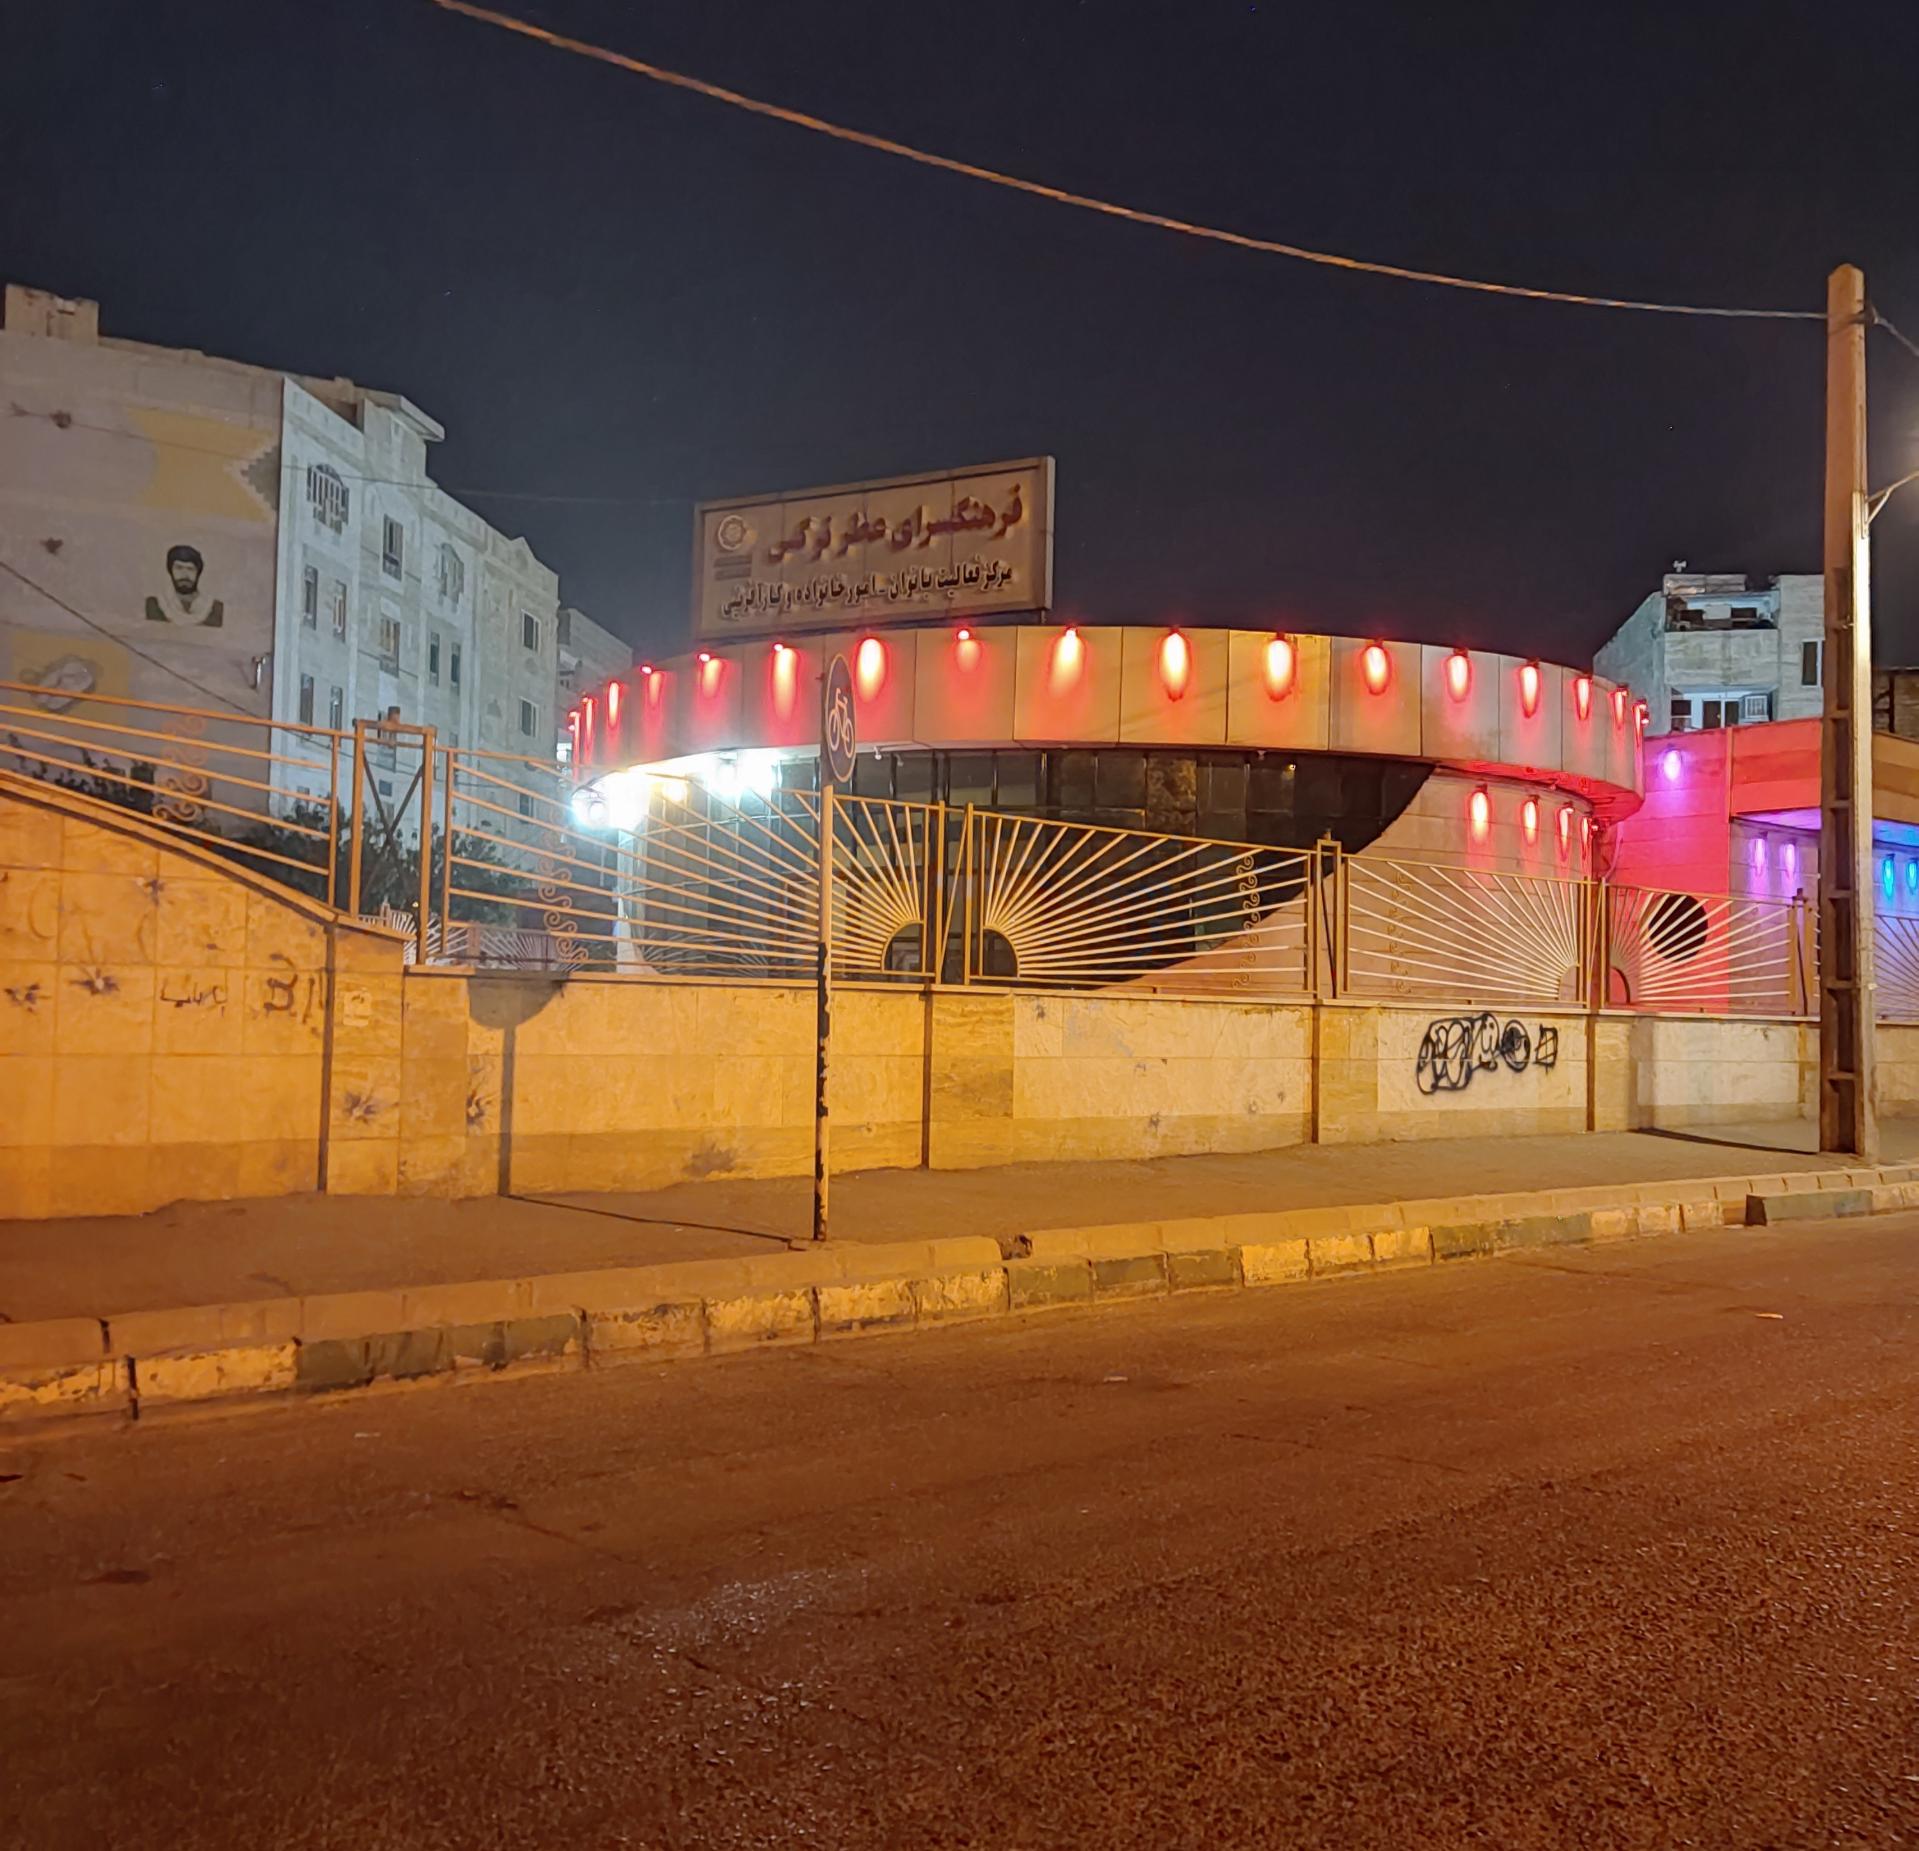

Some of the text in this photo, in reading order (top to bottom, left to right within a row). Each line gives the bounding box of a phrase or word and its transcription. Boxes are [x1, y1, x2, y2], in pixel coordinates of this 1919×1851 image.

[833, 509, 886, 559] عطر
[891, 482, 1023, 552] فرهنگسرای
[796, 573, 845, 608] خانواده
[845, 573, 876, 606] امور
[889, 565, 933, 600] بانوان
[935, 554, 981, 597] فعالیت
[981, 559, 1013, 590] مرکز
